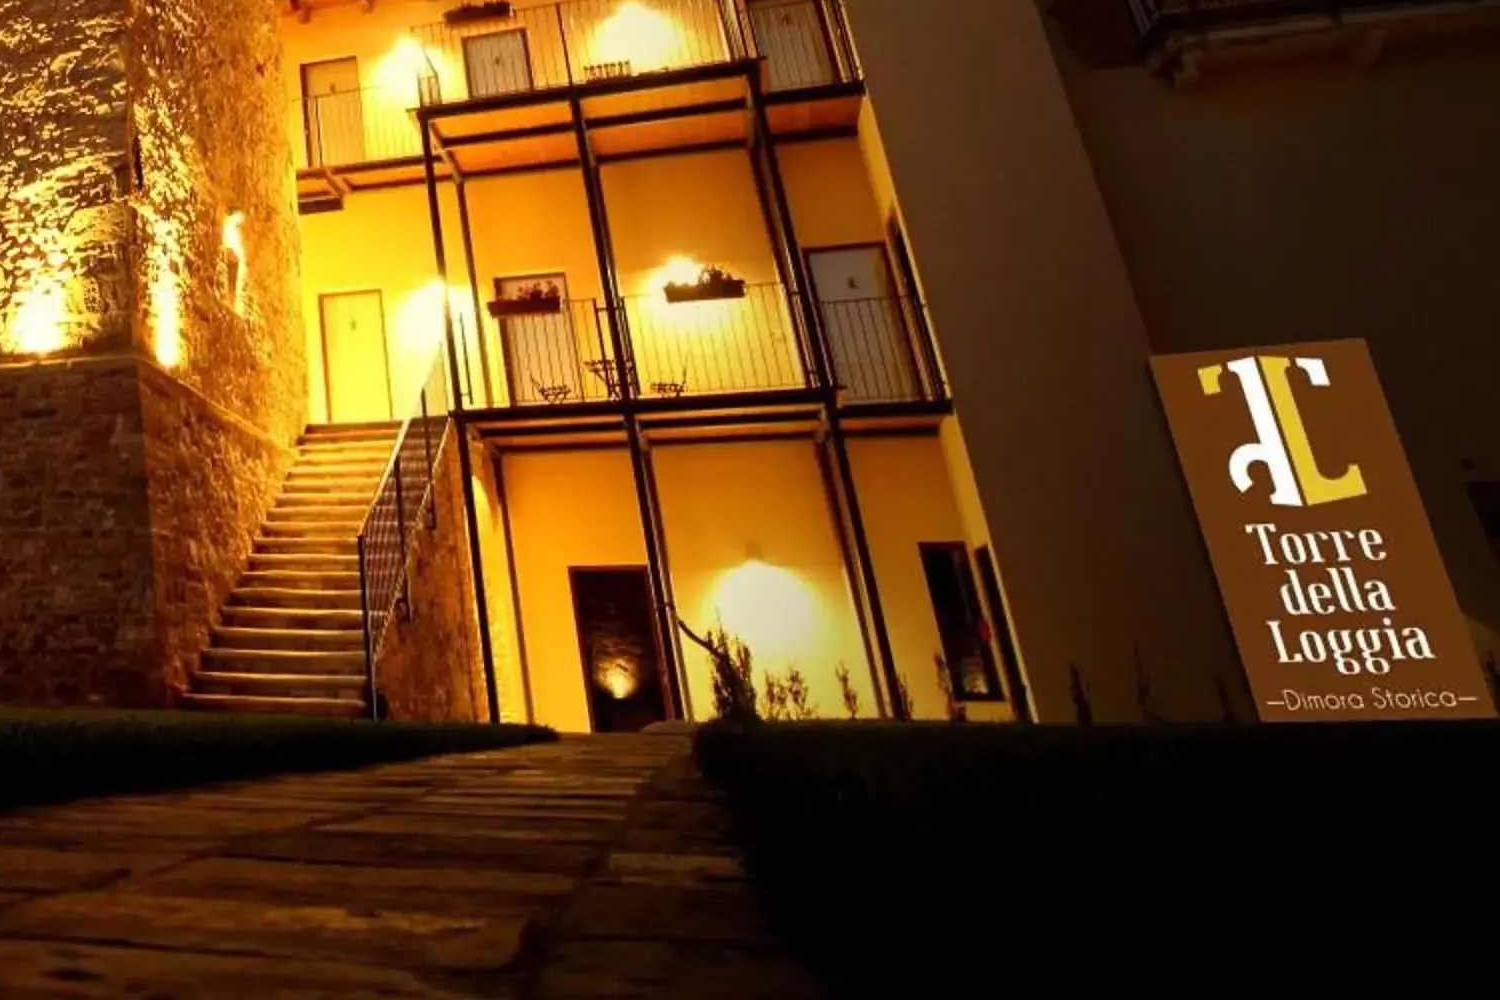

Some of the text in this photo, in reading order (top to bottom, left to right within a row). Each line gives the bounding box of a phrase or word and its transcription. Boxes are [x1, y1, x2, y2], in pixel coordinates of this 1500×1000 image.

[1245, 522, 1387, 566] Torre
[1279, 566, 1396, 616] della
[1266, 617, 1436, 675] Loggia
